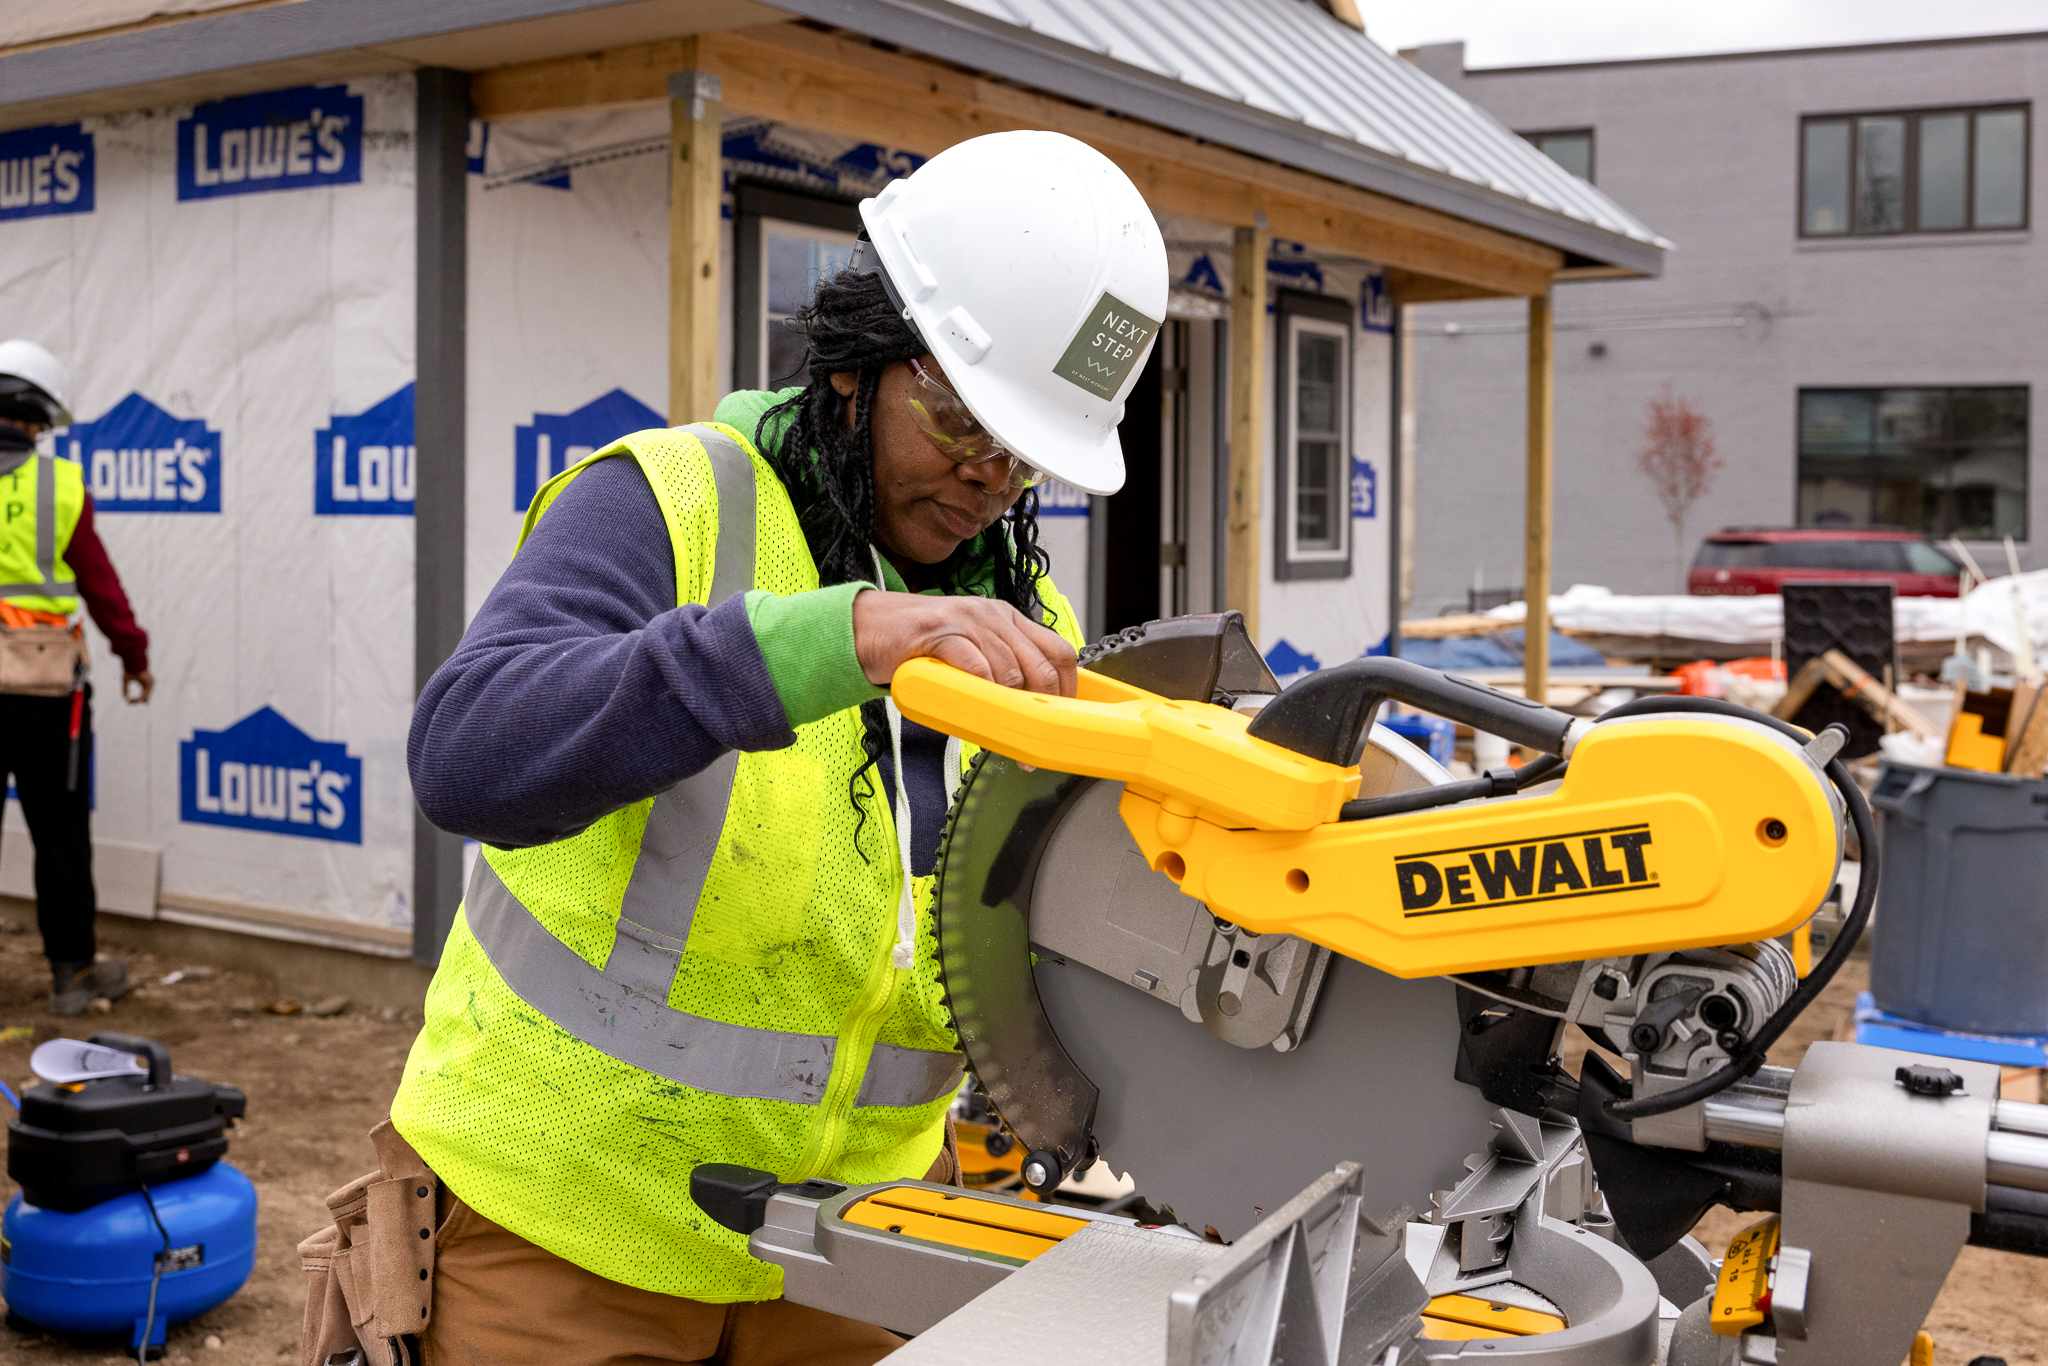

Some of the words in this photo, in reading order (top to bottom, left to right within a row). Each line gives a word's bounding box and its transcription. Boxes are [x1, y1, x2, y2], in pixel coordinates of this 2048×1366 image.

[194, 108, 346, 187] LOWE'S
[1091, 332, 1134, 361] STEP
[1102, 311, 1149, 344] NEXT
[195, 748, 346, 830] LOWE'S
[1395, 830, 1653, 911] DEWALT
[1728, 1268, 1739, 1283] 15
